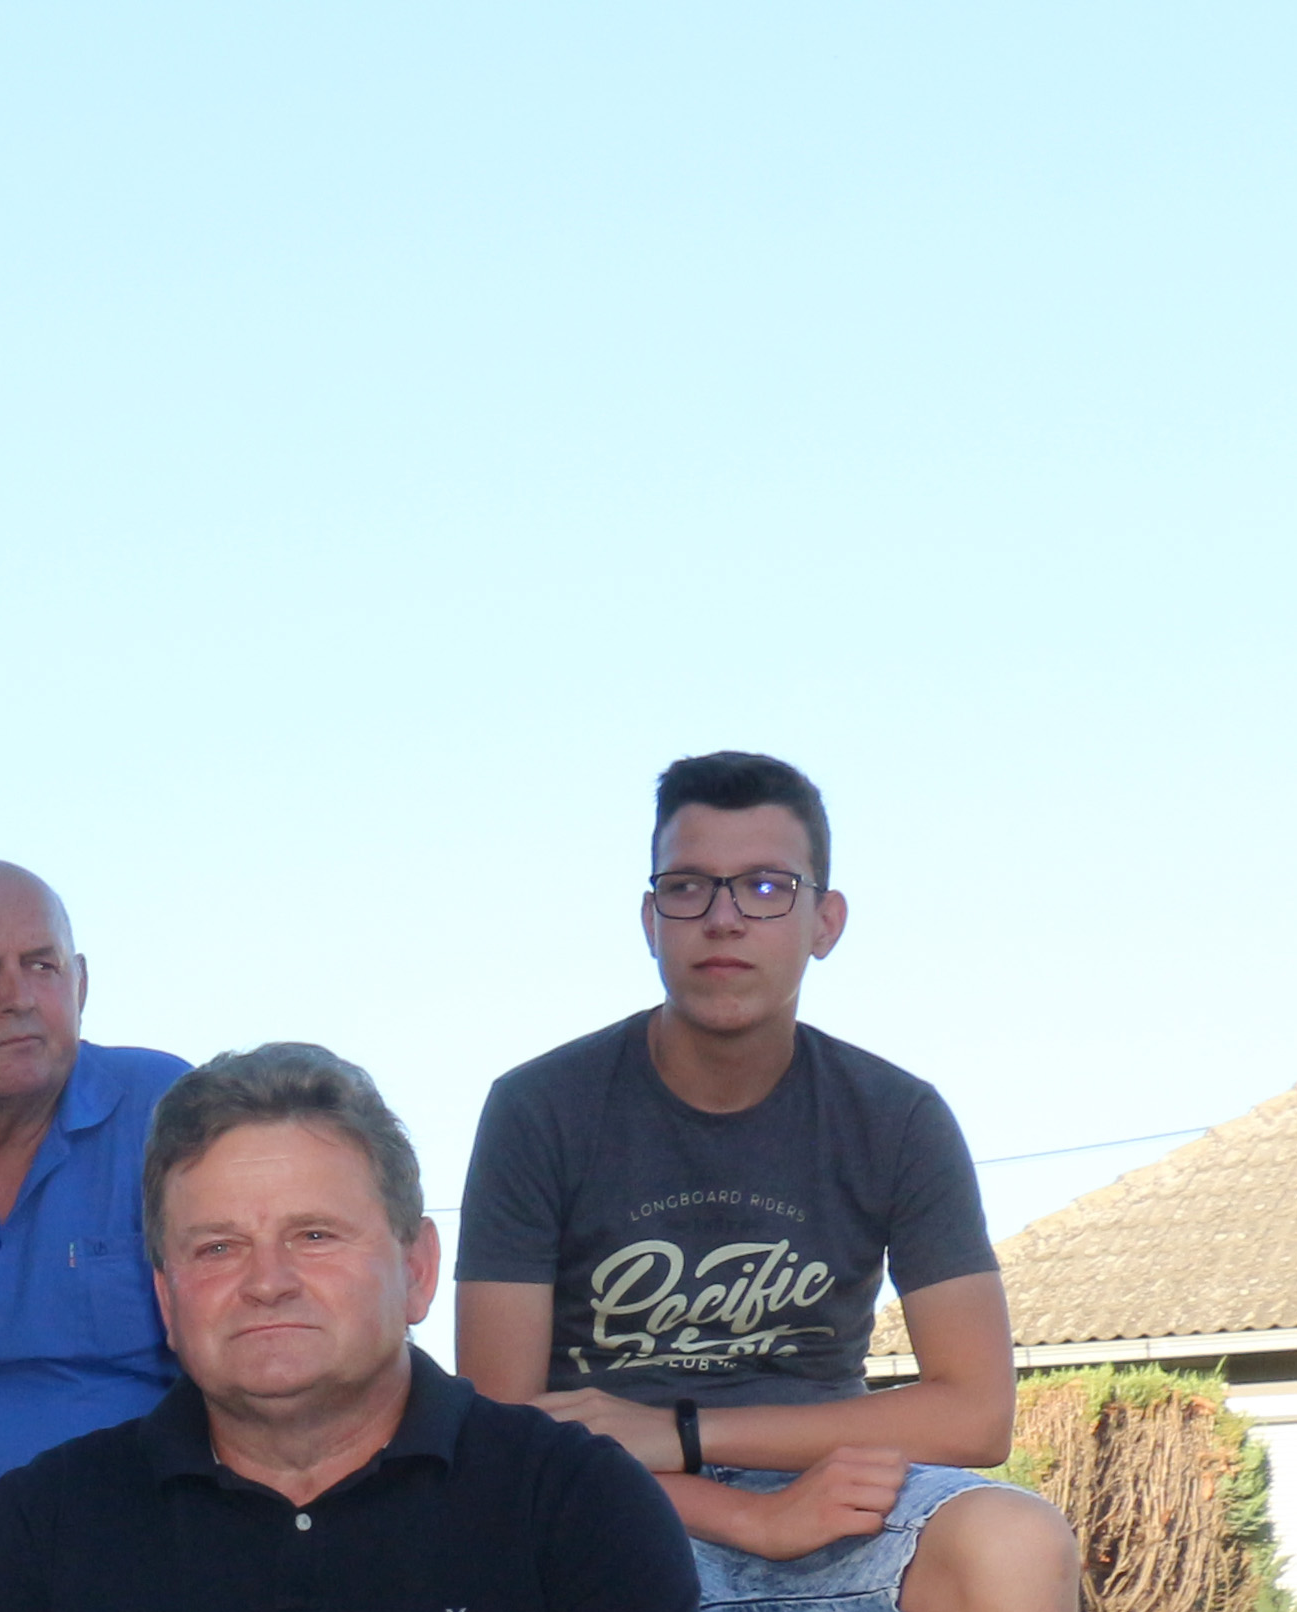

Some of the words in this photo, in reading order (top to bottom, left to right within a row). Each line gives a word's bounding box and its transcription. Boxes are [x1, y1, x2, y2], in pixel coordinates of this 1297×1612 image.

[630, 1190, 742, 1222] LONGBOARD
[750, 1193, 806, 1222] RIDERS
[590, 1239, 836, 1335] Pacific
